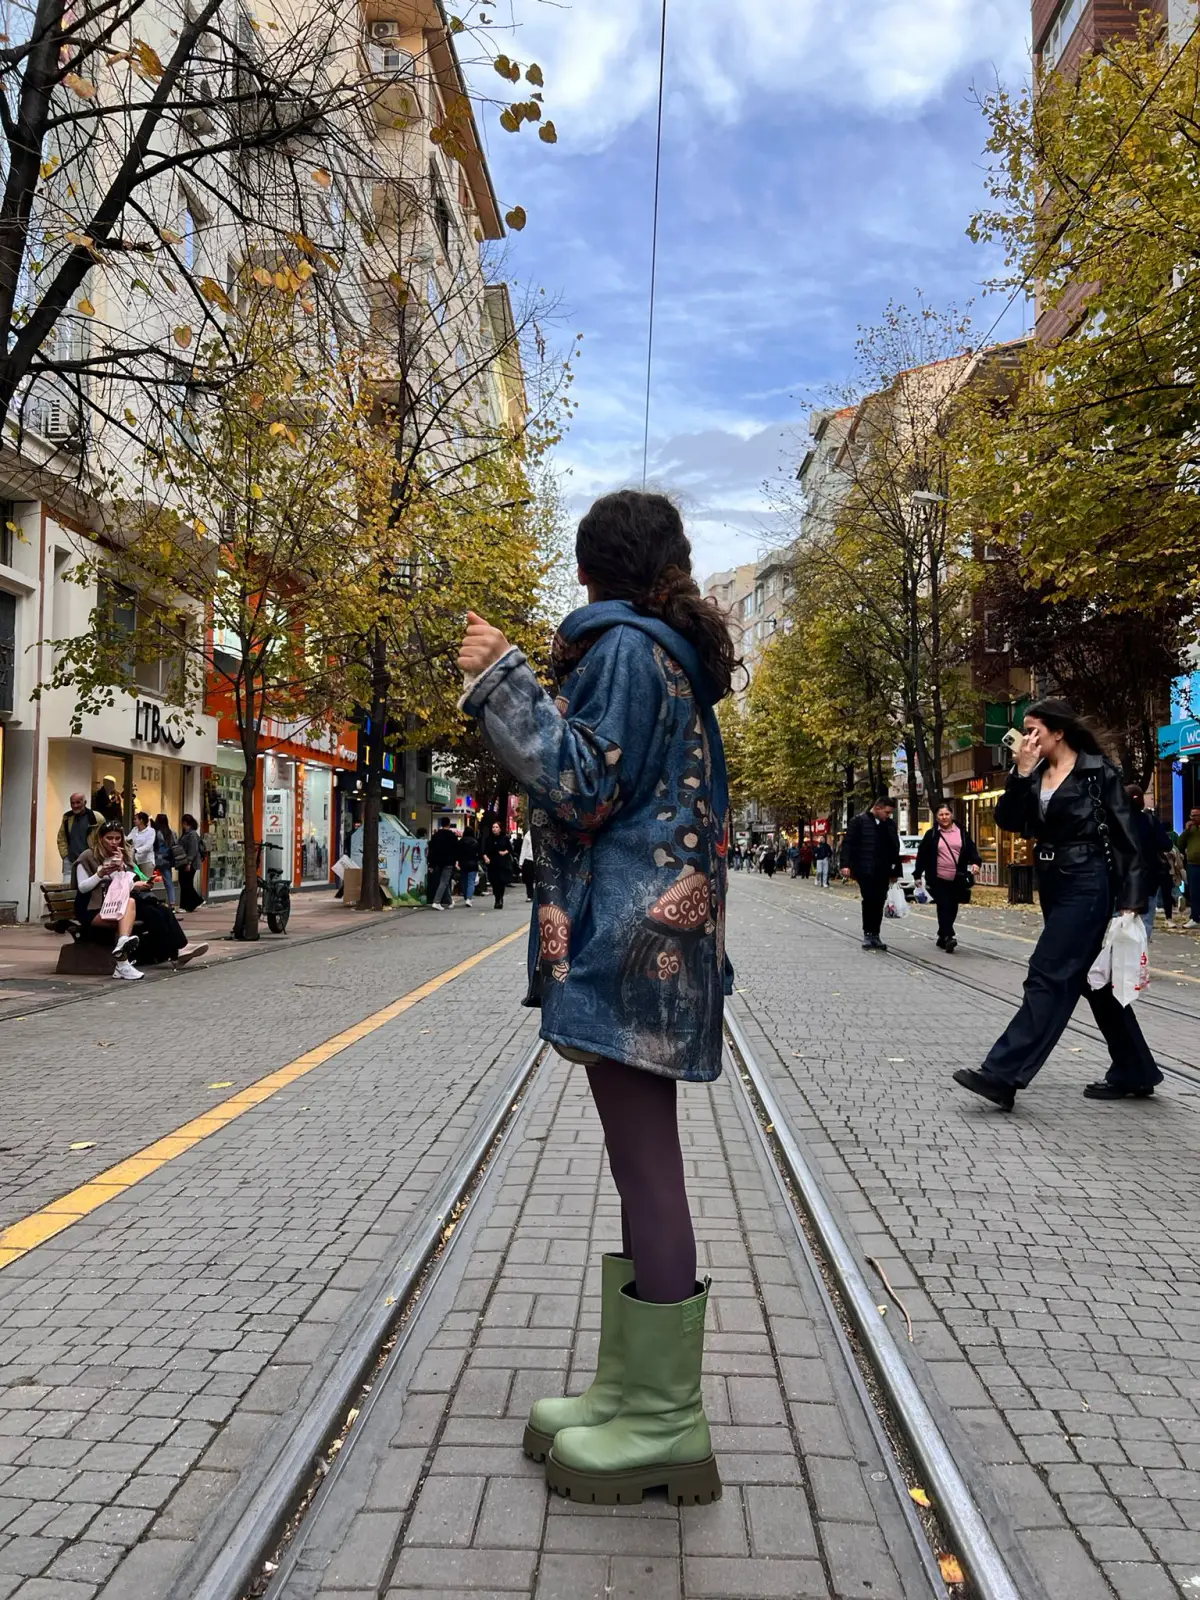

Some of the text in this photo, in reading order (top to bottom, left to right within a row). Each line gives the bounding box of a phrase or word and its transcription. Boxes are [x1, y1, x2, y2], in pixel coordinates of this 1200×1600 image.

[136, 699, 160, 744] LTB
[141, 765, 160, 781] LTB
[269, 815, 280, 827] 2
